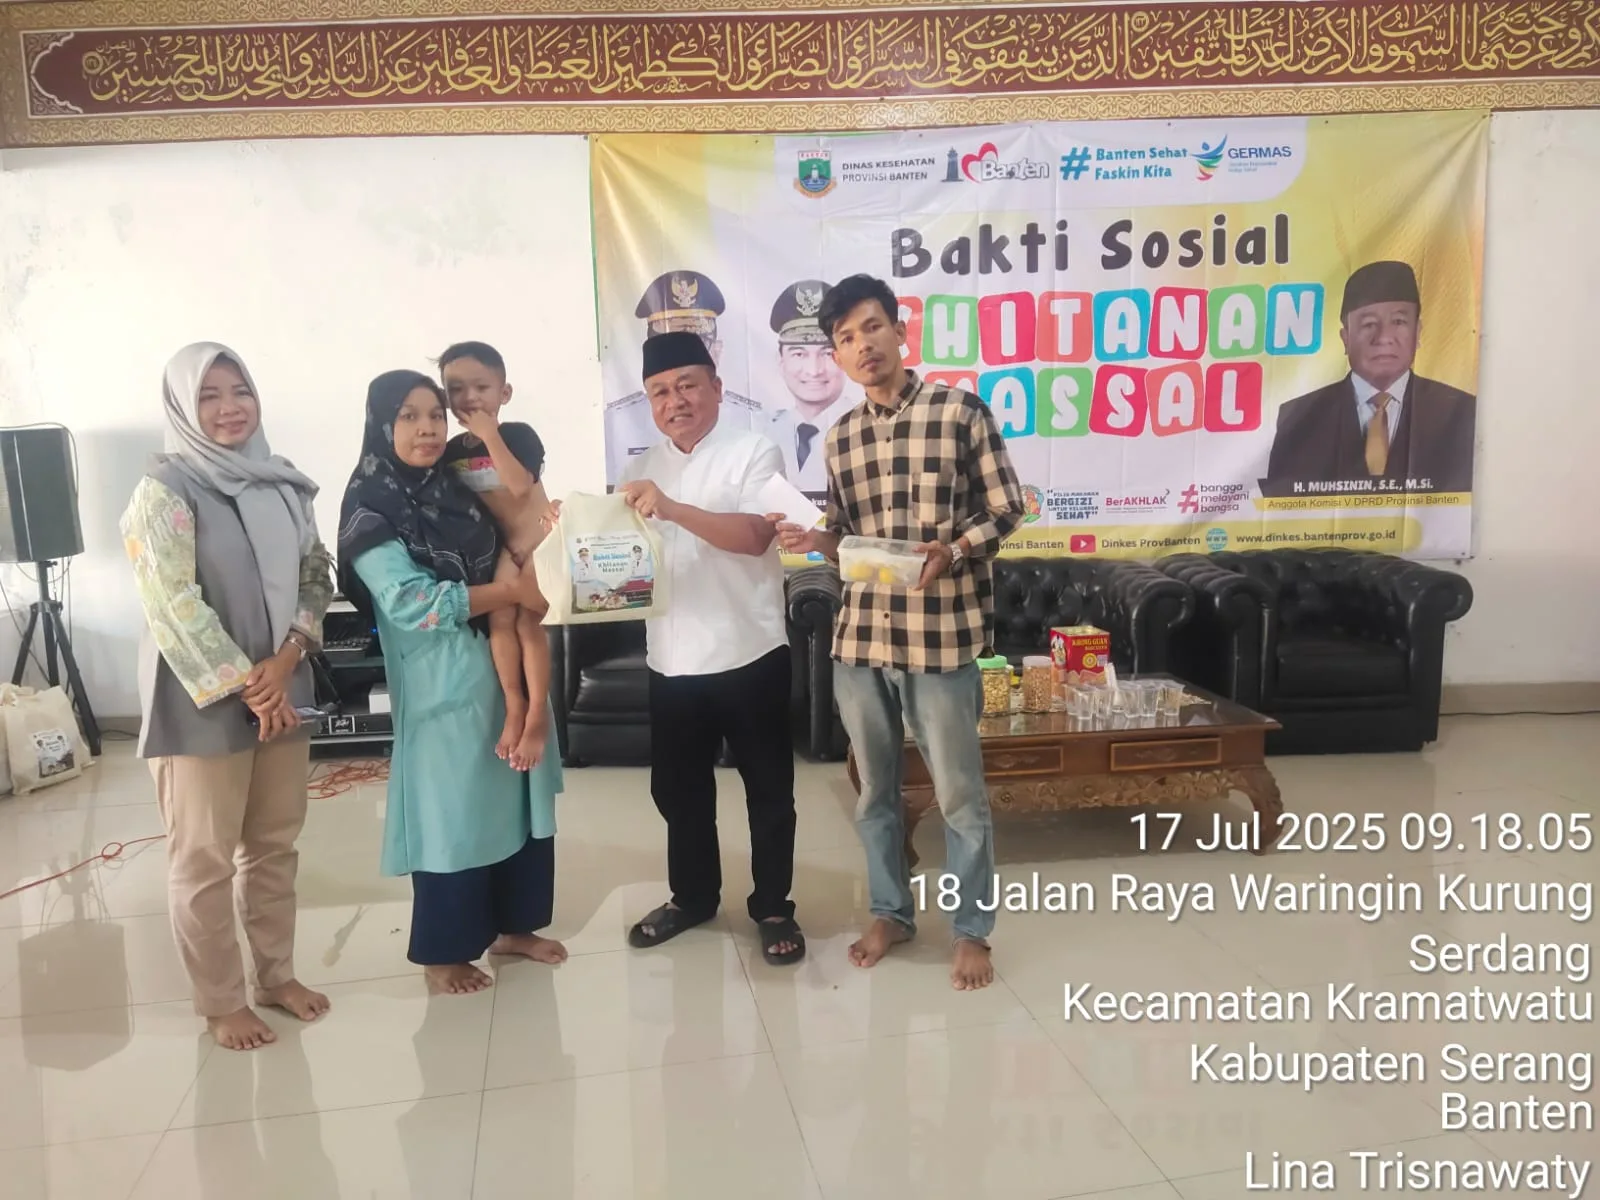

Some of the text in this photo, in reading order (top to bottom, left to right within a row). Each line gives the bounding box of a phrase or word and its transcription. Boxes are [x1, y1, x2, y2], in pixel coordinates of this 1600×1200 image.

[1096, 147, 1188, 161] Banten Sehat
[1227, 146, 1292, 159] GERMAS
[842, 157, 935, 170] DINAS KESEHATAN
[980, 158, 1050, 181] Banten
[842, 171, 928, 182] PROVINSI BANTEN
[1095, 165, 1172, 180] Faskin Kita
[891, 213, 1290, 278] Bakti Sosial
[934, 368, 1245, 433] ASSAL
[1200, 484, 1243, 494] bangga
[1293, 478, 1434, 492] H. MUHSININ, S.E., M.Si.
[1047, 497, 1092, 506] BERGIZI
[1105, 496, 1167, 506] BerAKHLAK
[1200, 491, 1250, 503] melayani
[1267, 494, 1459, 510] Anggota Komisi V DPRD Provinsi Banten
[1200, 503, 1240, 514] bangsa
[1101, 536, 1201, 549] Dinkes ProvBanten
[1236, 530, 1396, 544] www.dinkes.bantenprov.go.id
[999, 540, 1065, 550] vinsi Banten
